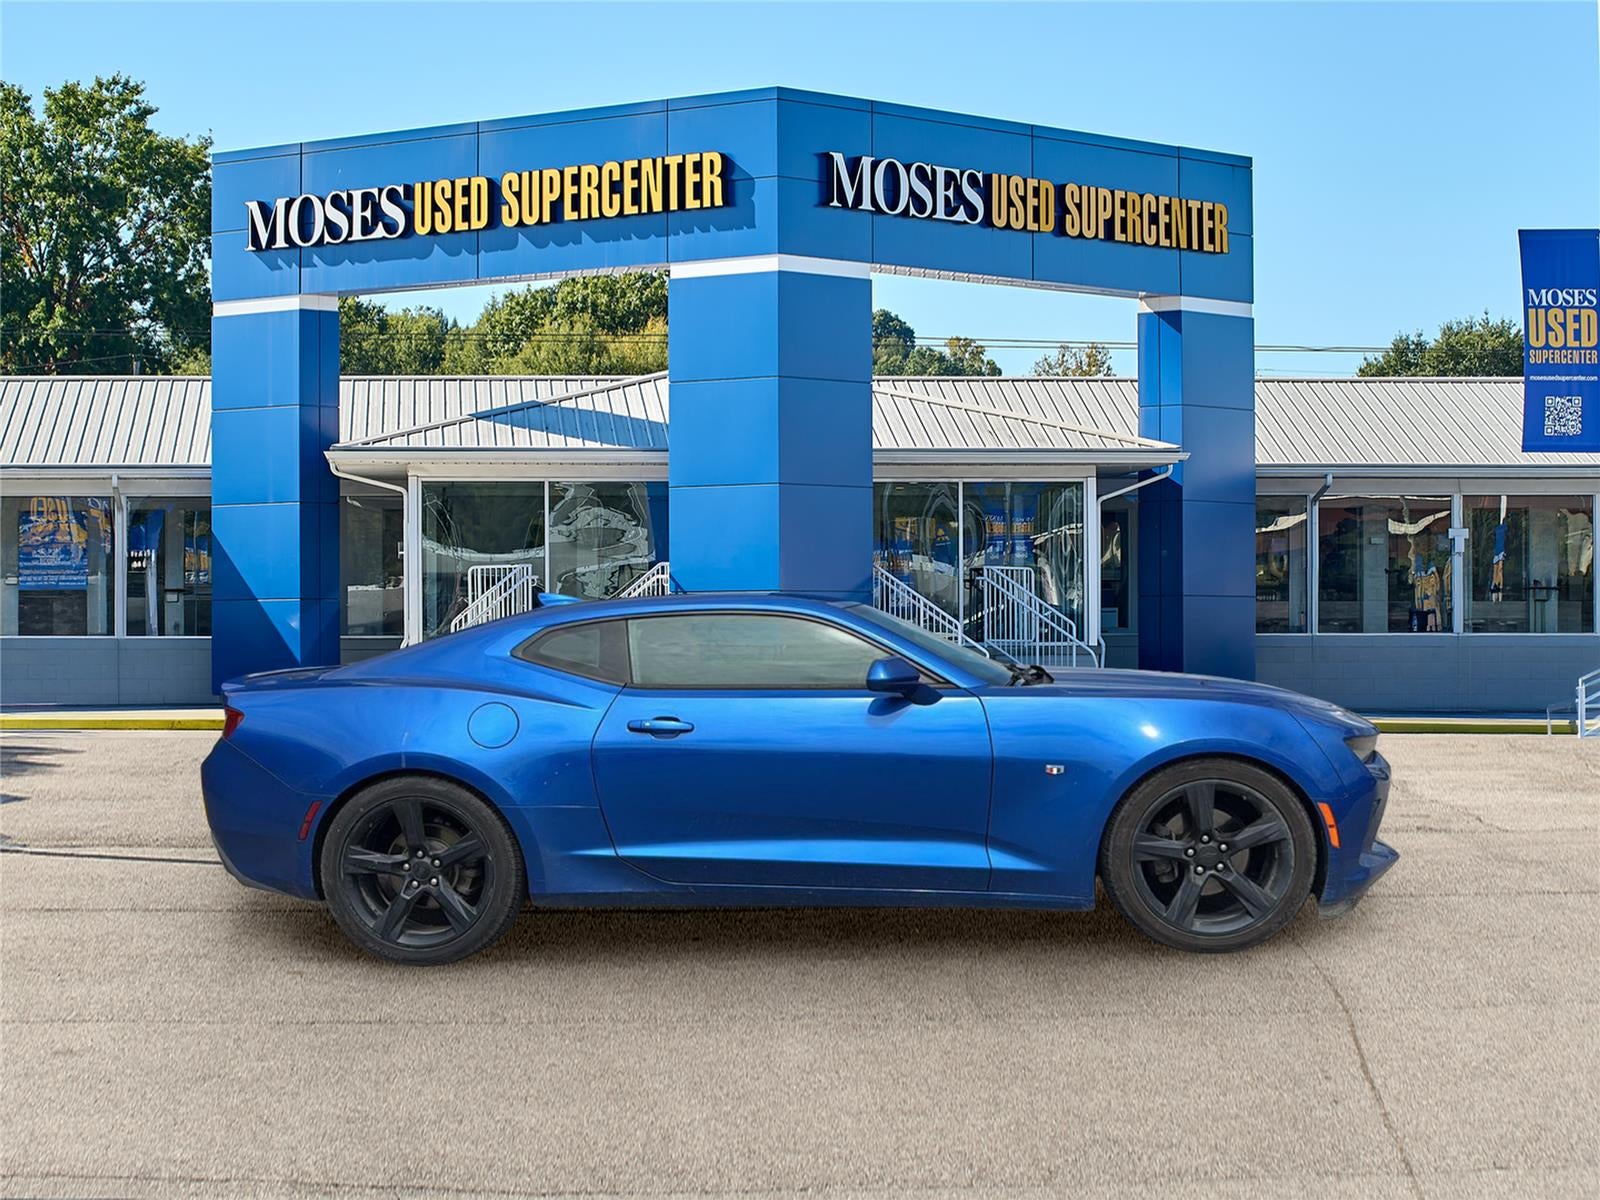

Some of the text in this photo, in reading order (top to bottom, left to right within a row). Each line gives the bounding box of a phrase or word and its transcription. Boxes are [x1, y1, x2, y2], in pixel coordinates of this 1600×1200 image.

[244, 151, 724, 252] MOSES USED SUPERCENTER
[829, 151, 1230, 254] MOSES USED SUPERCENTER
[1527, 288, 1598, 308] MOSES
[1528, 308, 1598, 348] USED
[1529, 349, 1598, 365] SUPERCENTER
[1529, 374, 1599, 382] mosesusedsupercenter.com
